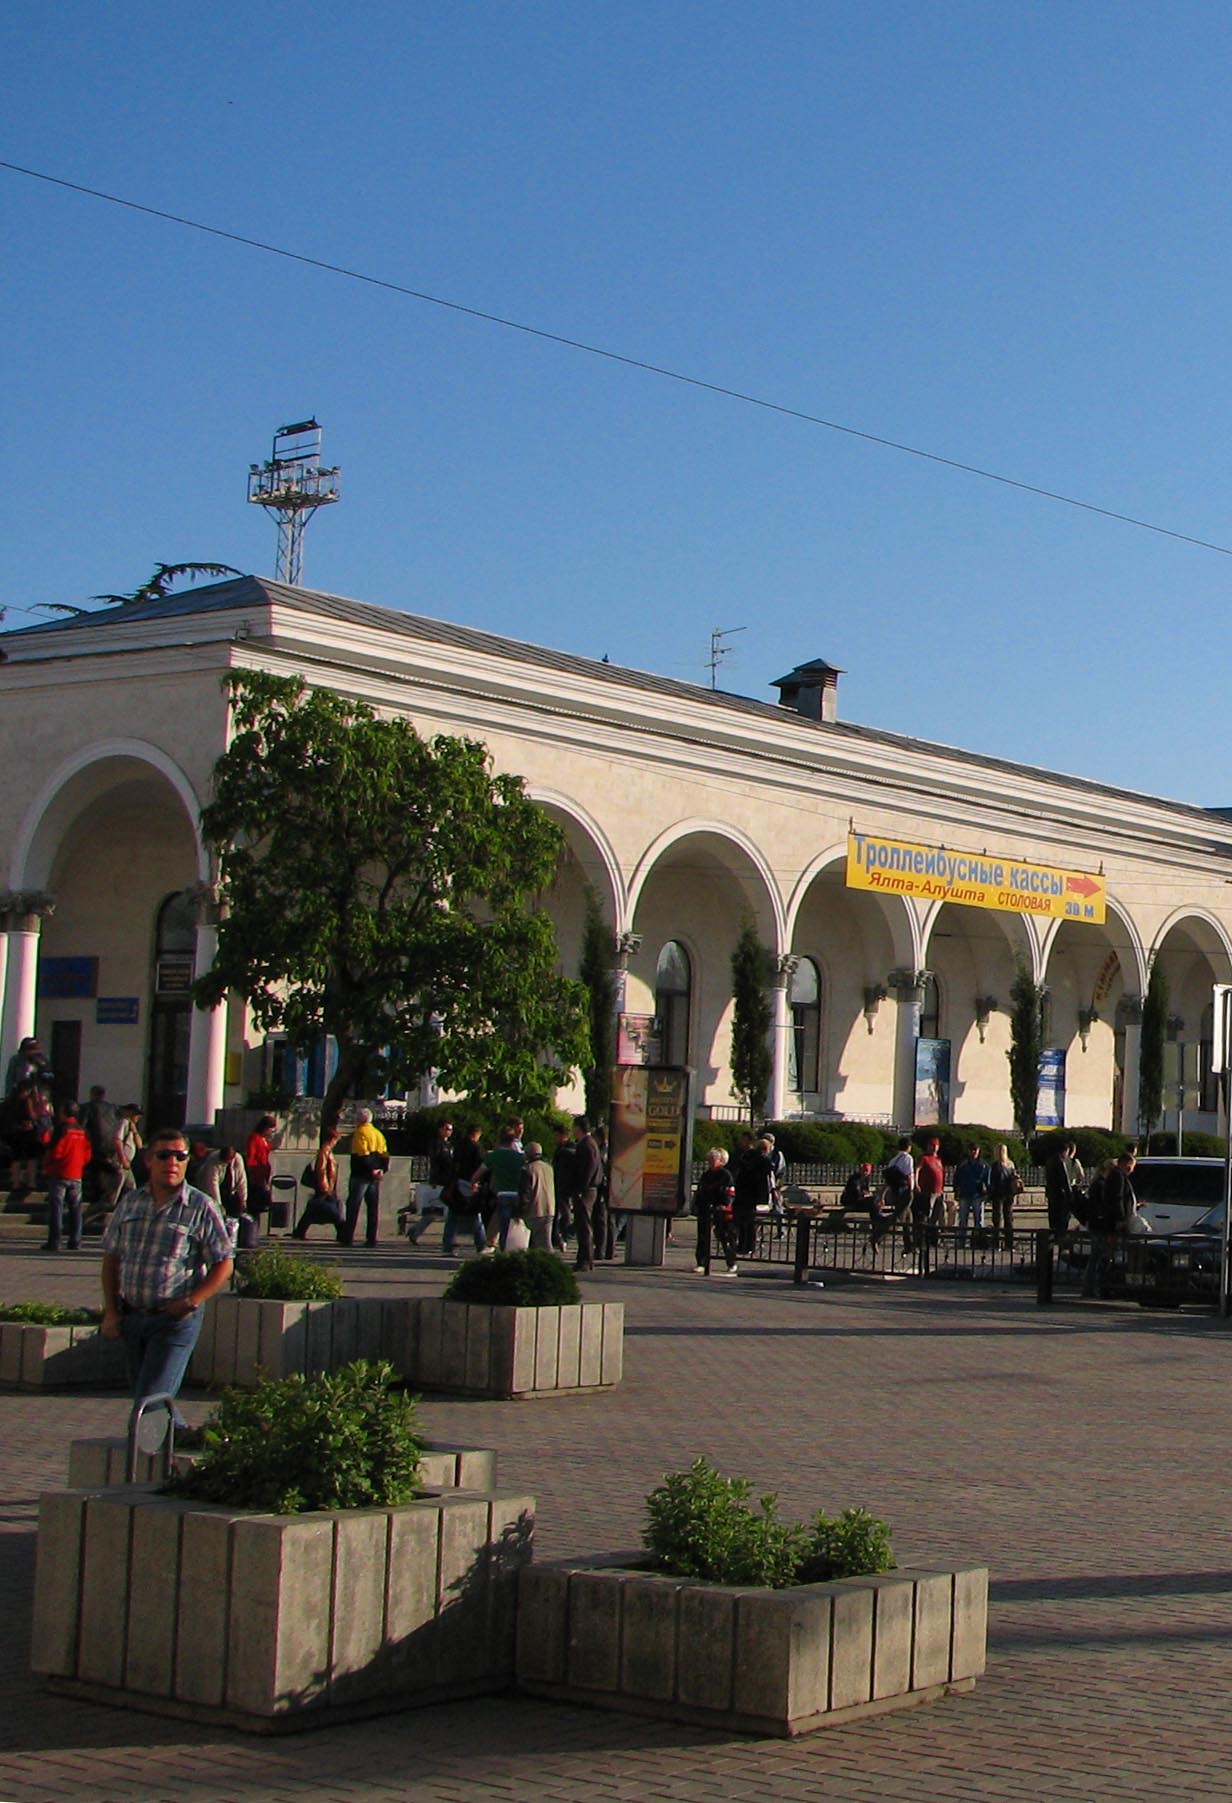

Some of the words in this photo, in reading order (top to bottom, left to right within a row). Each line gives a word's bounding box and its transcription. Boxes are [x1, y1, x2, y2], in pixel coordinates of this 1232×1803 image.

[854, 835, 1004, 887] Троллейбусные
[1010, 867, 1063, 896] кассы
[998, 891, 1052, 911] СТОЛОВАЯ
[1065, 901, 1080, 915] 30
